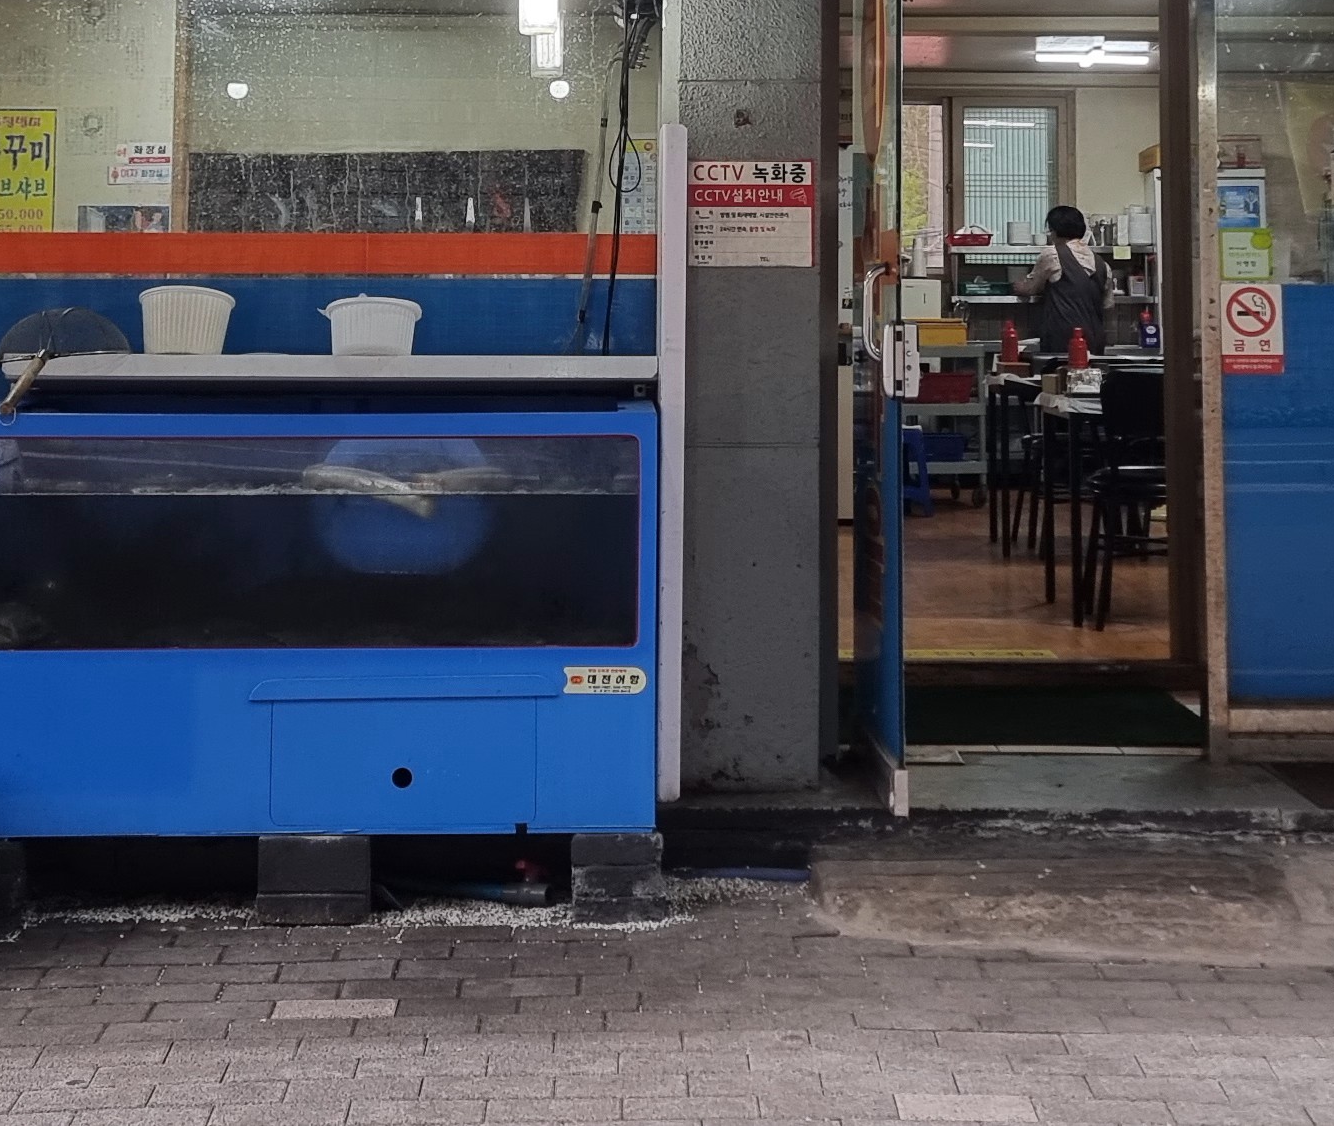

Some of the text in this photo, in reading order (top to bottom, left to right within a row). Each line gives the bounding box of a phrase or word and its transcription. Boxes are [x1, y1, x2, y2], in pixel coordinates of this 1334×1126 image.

[134, 145, 166, 154] 화장실
[694, 163, 806, 183] CCTV 녹화중
[694, 188, 783, 203] CCTV설치안내
